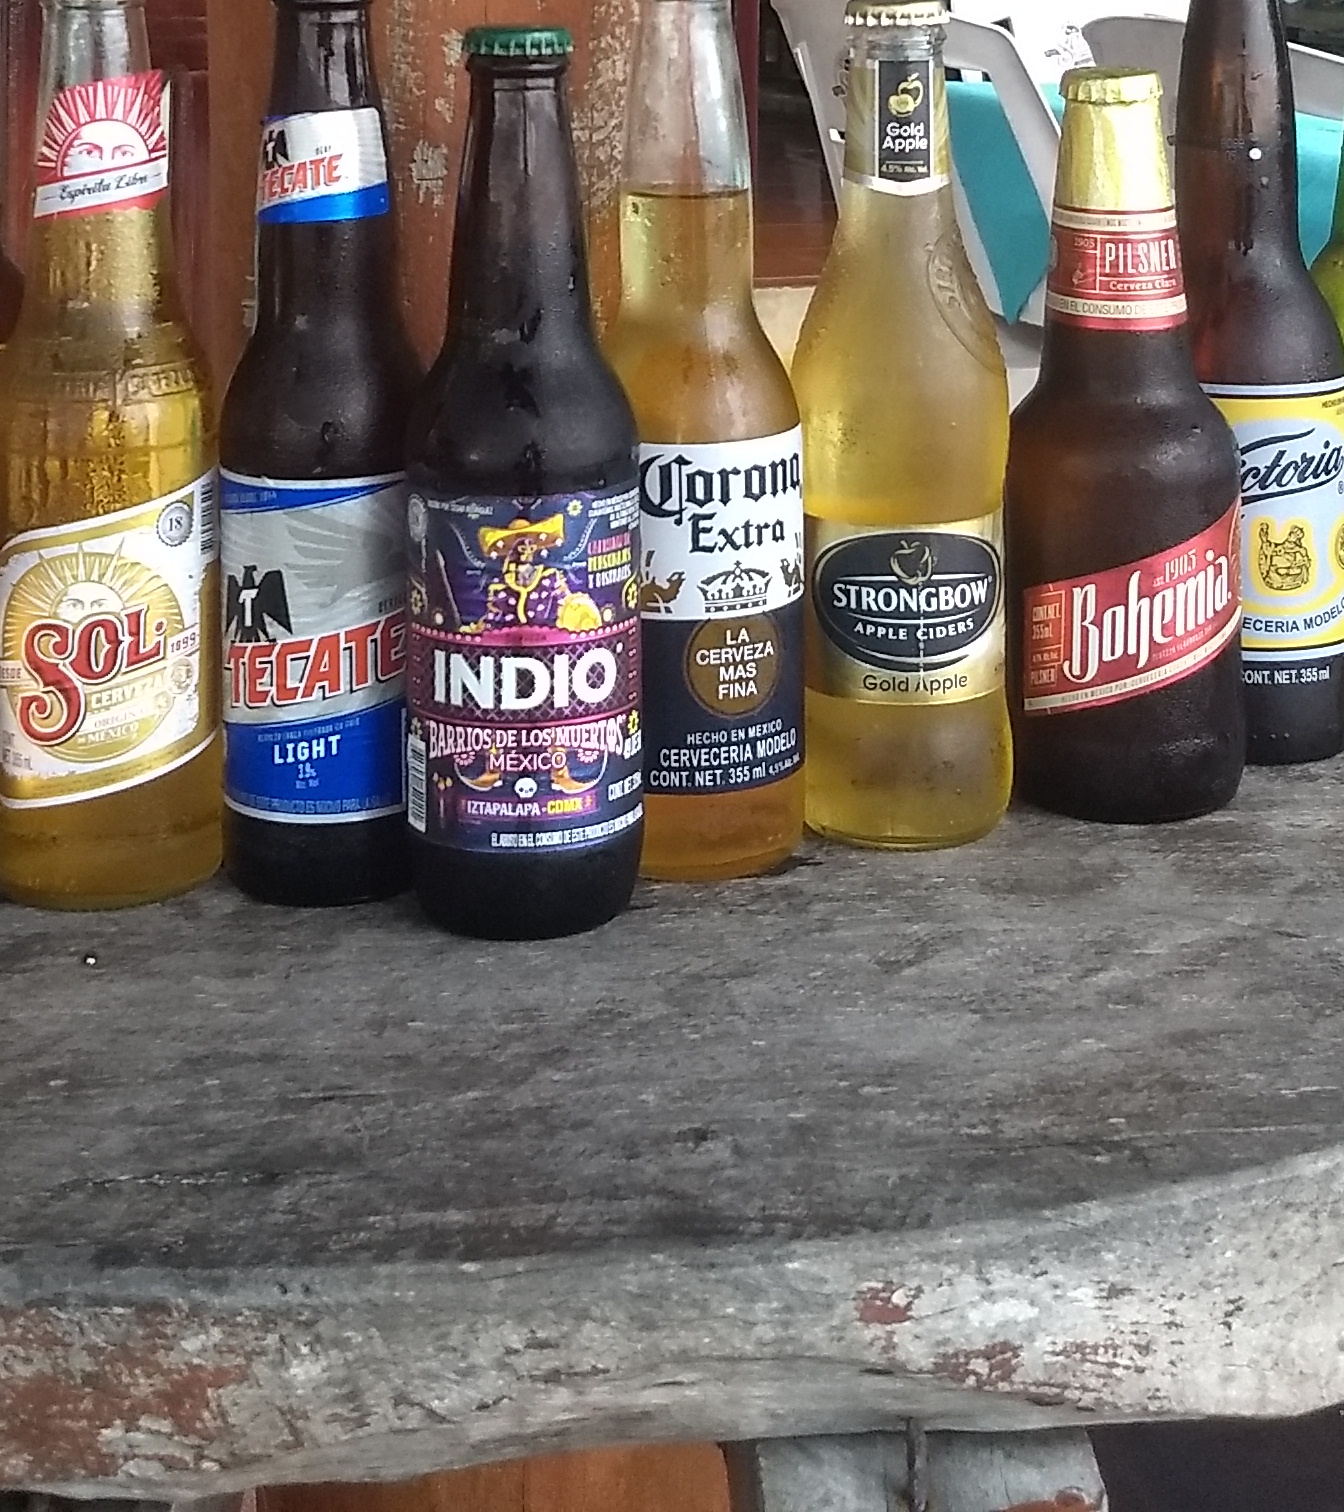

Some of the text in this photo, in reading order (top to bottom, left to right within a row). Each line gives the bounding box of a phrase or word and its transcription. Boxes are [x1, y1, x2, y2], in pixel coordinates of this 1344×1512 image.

[886, 122, 925, 137] Gold
[882, 135, 928, 153] Apple
[262, 153, 343, 202] TECATE
[1074, 237, 1095, 248] 1905
[1105, 239, 1177, 275] PILSNER
[1109, 280, 1152, 291] Cerveza
[1081, 302, 1132, 316] CONSUMO
[1241, 428, 1344, 498] ctoria
[639, 452, 800, 527] Corona
[169, 516, 183, 532] 18
[688, 512, 785, 554] Extra
[1164, 548, 1197, 583] 1905
[833, 577, 988, 613] STRONGBOW
[1062, 549, 1232, 683] Bohemia
[1242, 616, 1300, 634] ECERIA
[725, 628, 750, 646] LA
[854, 618, 974, 640] APPLE CIDERS
[224, 610, 406, 709] TECATE
[695, 640, 775, 665] CERVEZA
[19, 607, 166, 744] SOL
[434, 647, 617, 710] INDIO
[719, 662, 757, 682] MAS
[1274, 670, 1298, 684] NET.
[1300, 668, 1318, 682] 355
[1319, 665, 1330, 681] ml
[718, 684, 758, 700] FINA
[862, 673, 968, 696] Gold Apple
[496, 729, 517, 748] DE
[521, 728, 552, 747] LOS
[687, 718, 783, 745] HECHO EN MEXICO
[273, 734, 341, 765] LIGHT
[659, 727, 796, 768] CERVECERIA MODELO
[489, 749, 567, 772] MÉXICO
[649, 770, 692, 788] CONT.
[695, 769, 726, 786] NET.
[728, 765, 750, 784] 355
[752, 761, 766, 779] ml
[467, 798, 584, 816] IZTAPALAPA CDMX
